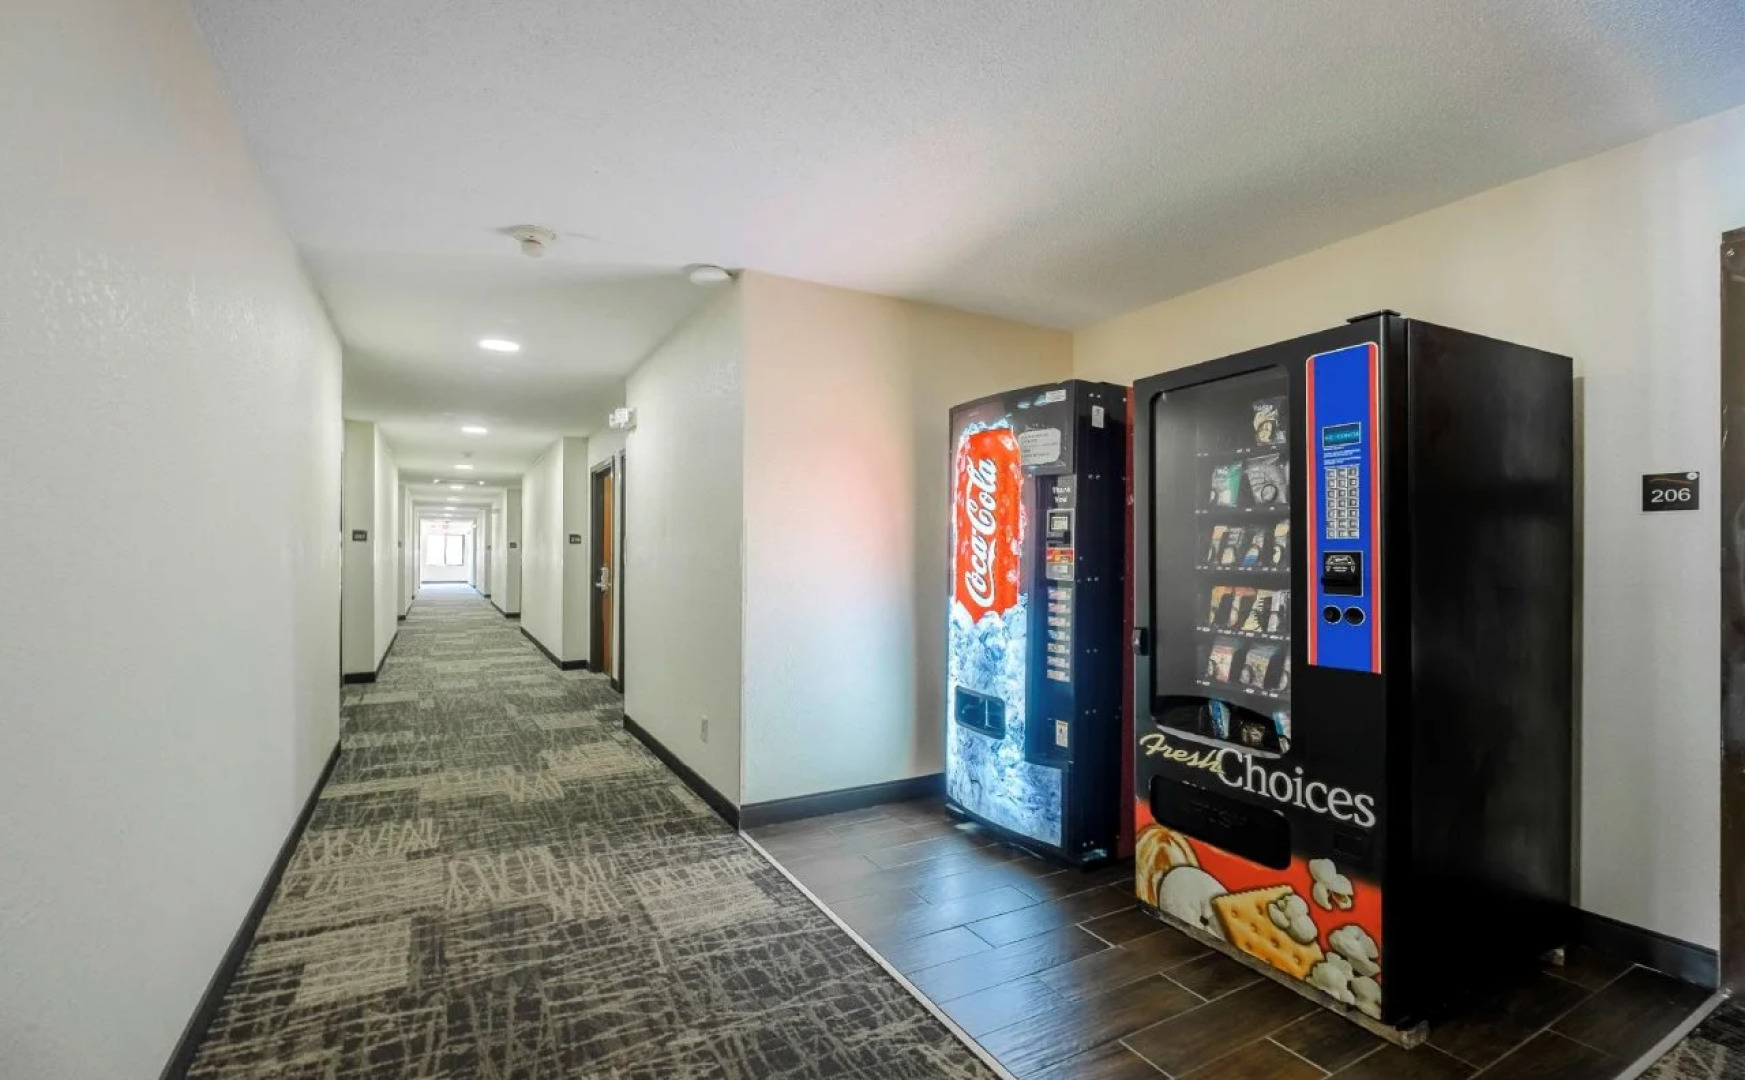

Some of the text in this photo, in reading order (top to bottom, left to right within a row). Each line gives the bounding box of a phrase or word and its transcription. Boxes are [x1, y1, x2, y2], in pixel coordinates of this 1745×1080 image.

[965, 456, 996, 608] Coca-Cola
[1651, 488, 1691, 502] 206
[1140, 733, 1376, 828] Fresh Choices
